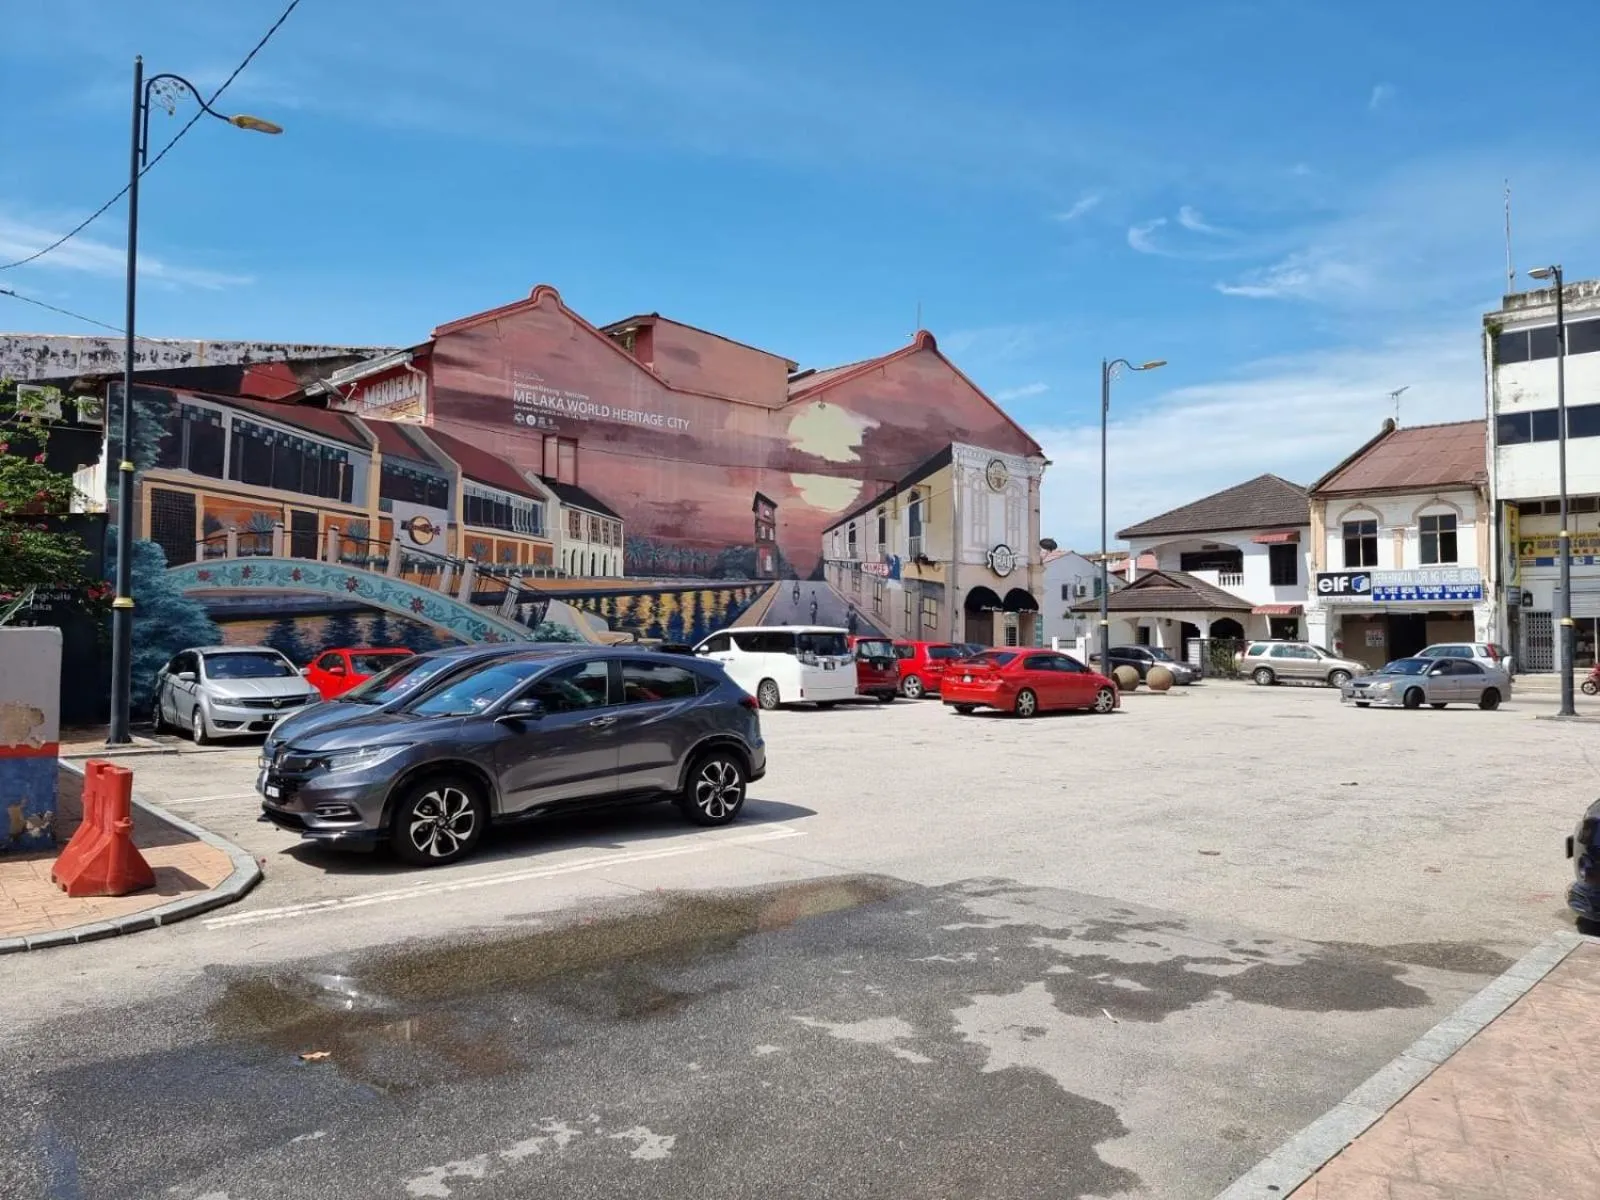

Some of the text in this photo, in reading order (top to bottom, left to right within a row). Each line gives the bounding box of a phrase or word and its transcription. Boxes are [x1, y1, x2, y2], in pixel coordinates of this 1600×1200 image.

[363, 373, 420, 411] MERDEKA
[513, 389, 565, 410] MELAKA
[567, 398, 610, 417] WORLD
[612, 410, 664, 427] HERITAGE
[667, 416, 690, 431] CITY
[1318, 576, 1348, 593] elf
[1419, 585, 1443, 593] TRADING
[1445, 584, 1479, 593] TRANSPORT
